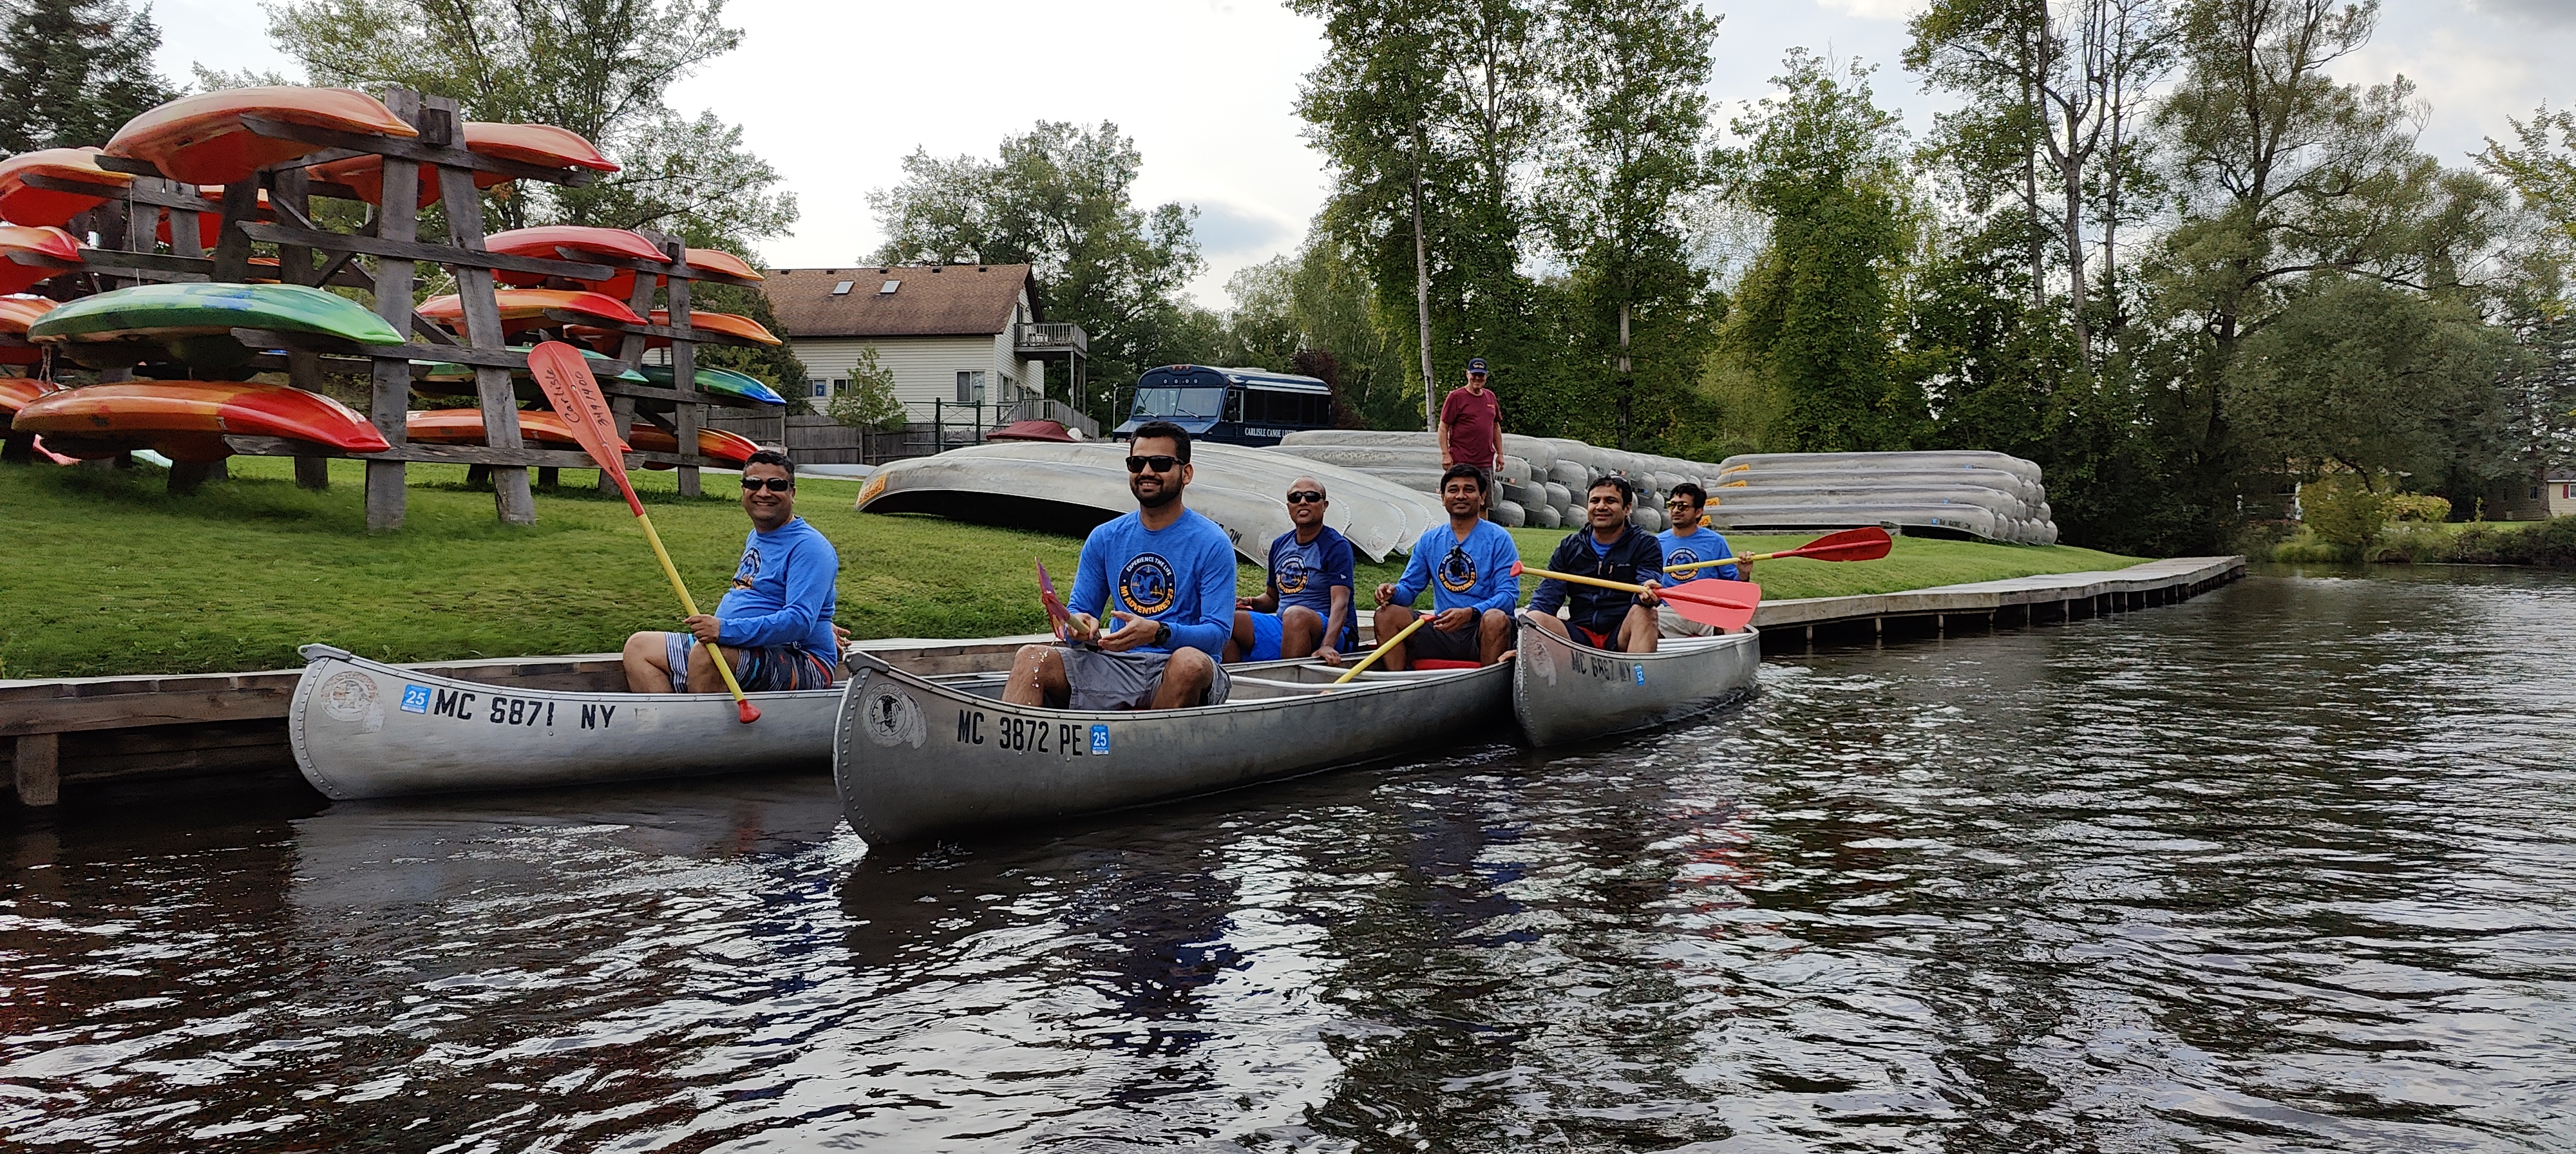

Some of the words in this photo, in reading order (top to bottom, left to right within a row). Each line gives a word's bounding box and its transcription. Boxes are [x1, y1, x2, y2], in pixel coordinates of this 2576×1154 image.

[545, 366, 580, 423] Carlisle
[575, 371, 597, 401] 1400
[591, 404, 611, 426] 349
[1244, 428, 1266, 437] CARLISLE
[1267, 428, 1281, 437] CANOE
[1126, 556, 1155, 572] EXPERIENCE
[1155, 558, 1165, 567] THE
[1163, 564, 1172, 576] LIFE
[1571, 650, 1587, 675] MC
[405, 690, 426, 706] 25
[433, 689, 476, 721] MC
[489, 697, 555, 727] 6871
[581, 704, 616, 730] NY
[957, 709, 985, 745] MC
[999, 717, 1050, 753] 3872
[1060, 724, 1083, 756] PE
[1093, 732, 1107, 747] 25
